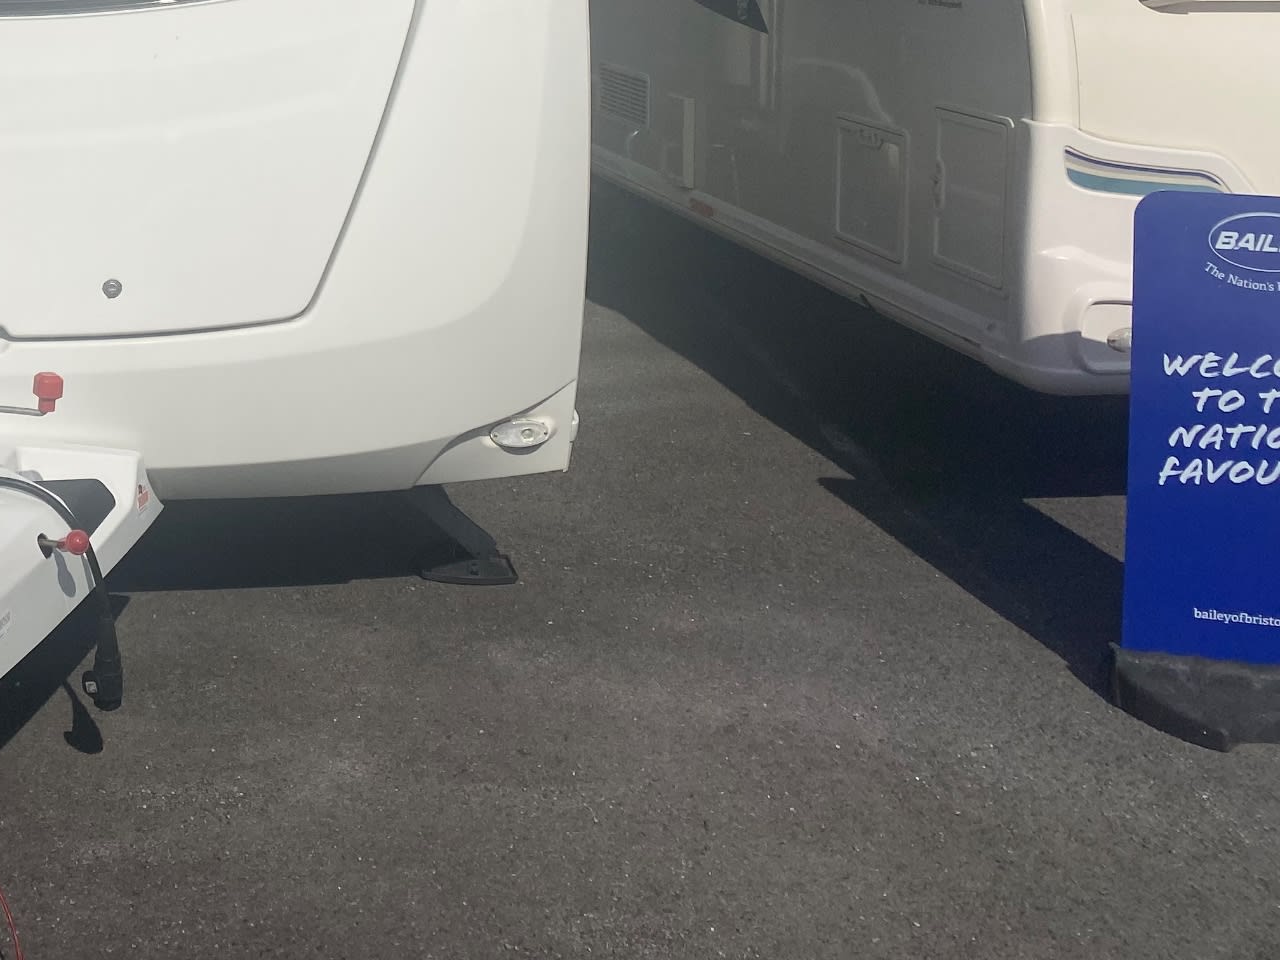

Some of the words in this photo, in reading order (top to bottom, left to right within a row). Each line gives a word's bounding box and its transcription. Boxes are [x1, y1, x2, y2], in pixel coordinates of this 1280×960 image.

[1204, 261, 1226, 280] The
[1227, 273, 1275, 292] Nation's
[1163, 351, 1280, 379] WELC
[1191, 386, 1246, 413] TO
[1193, 607, 1280, 627] baileyofbristo
